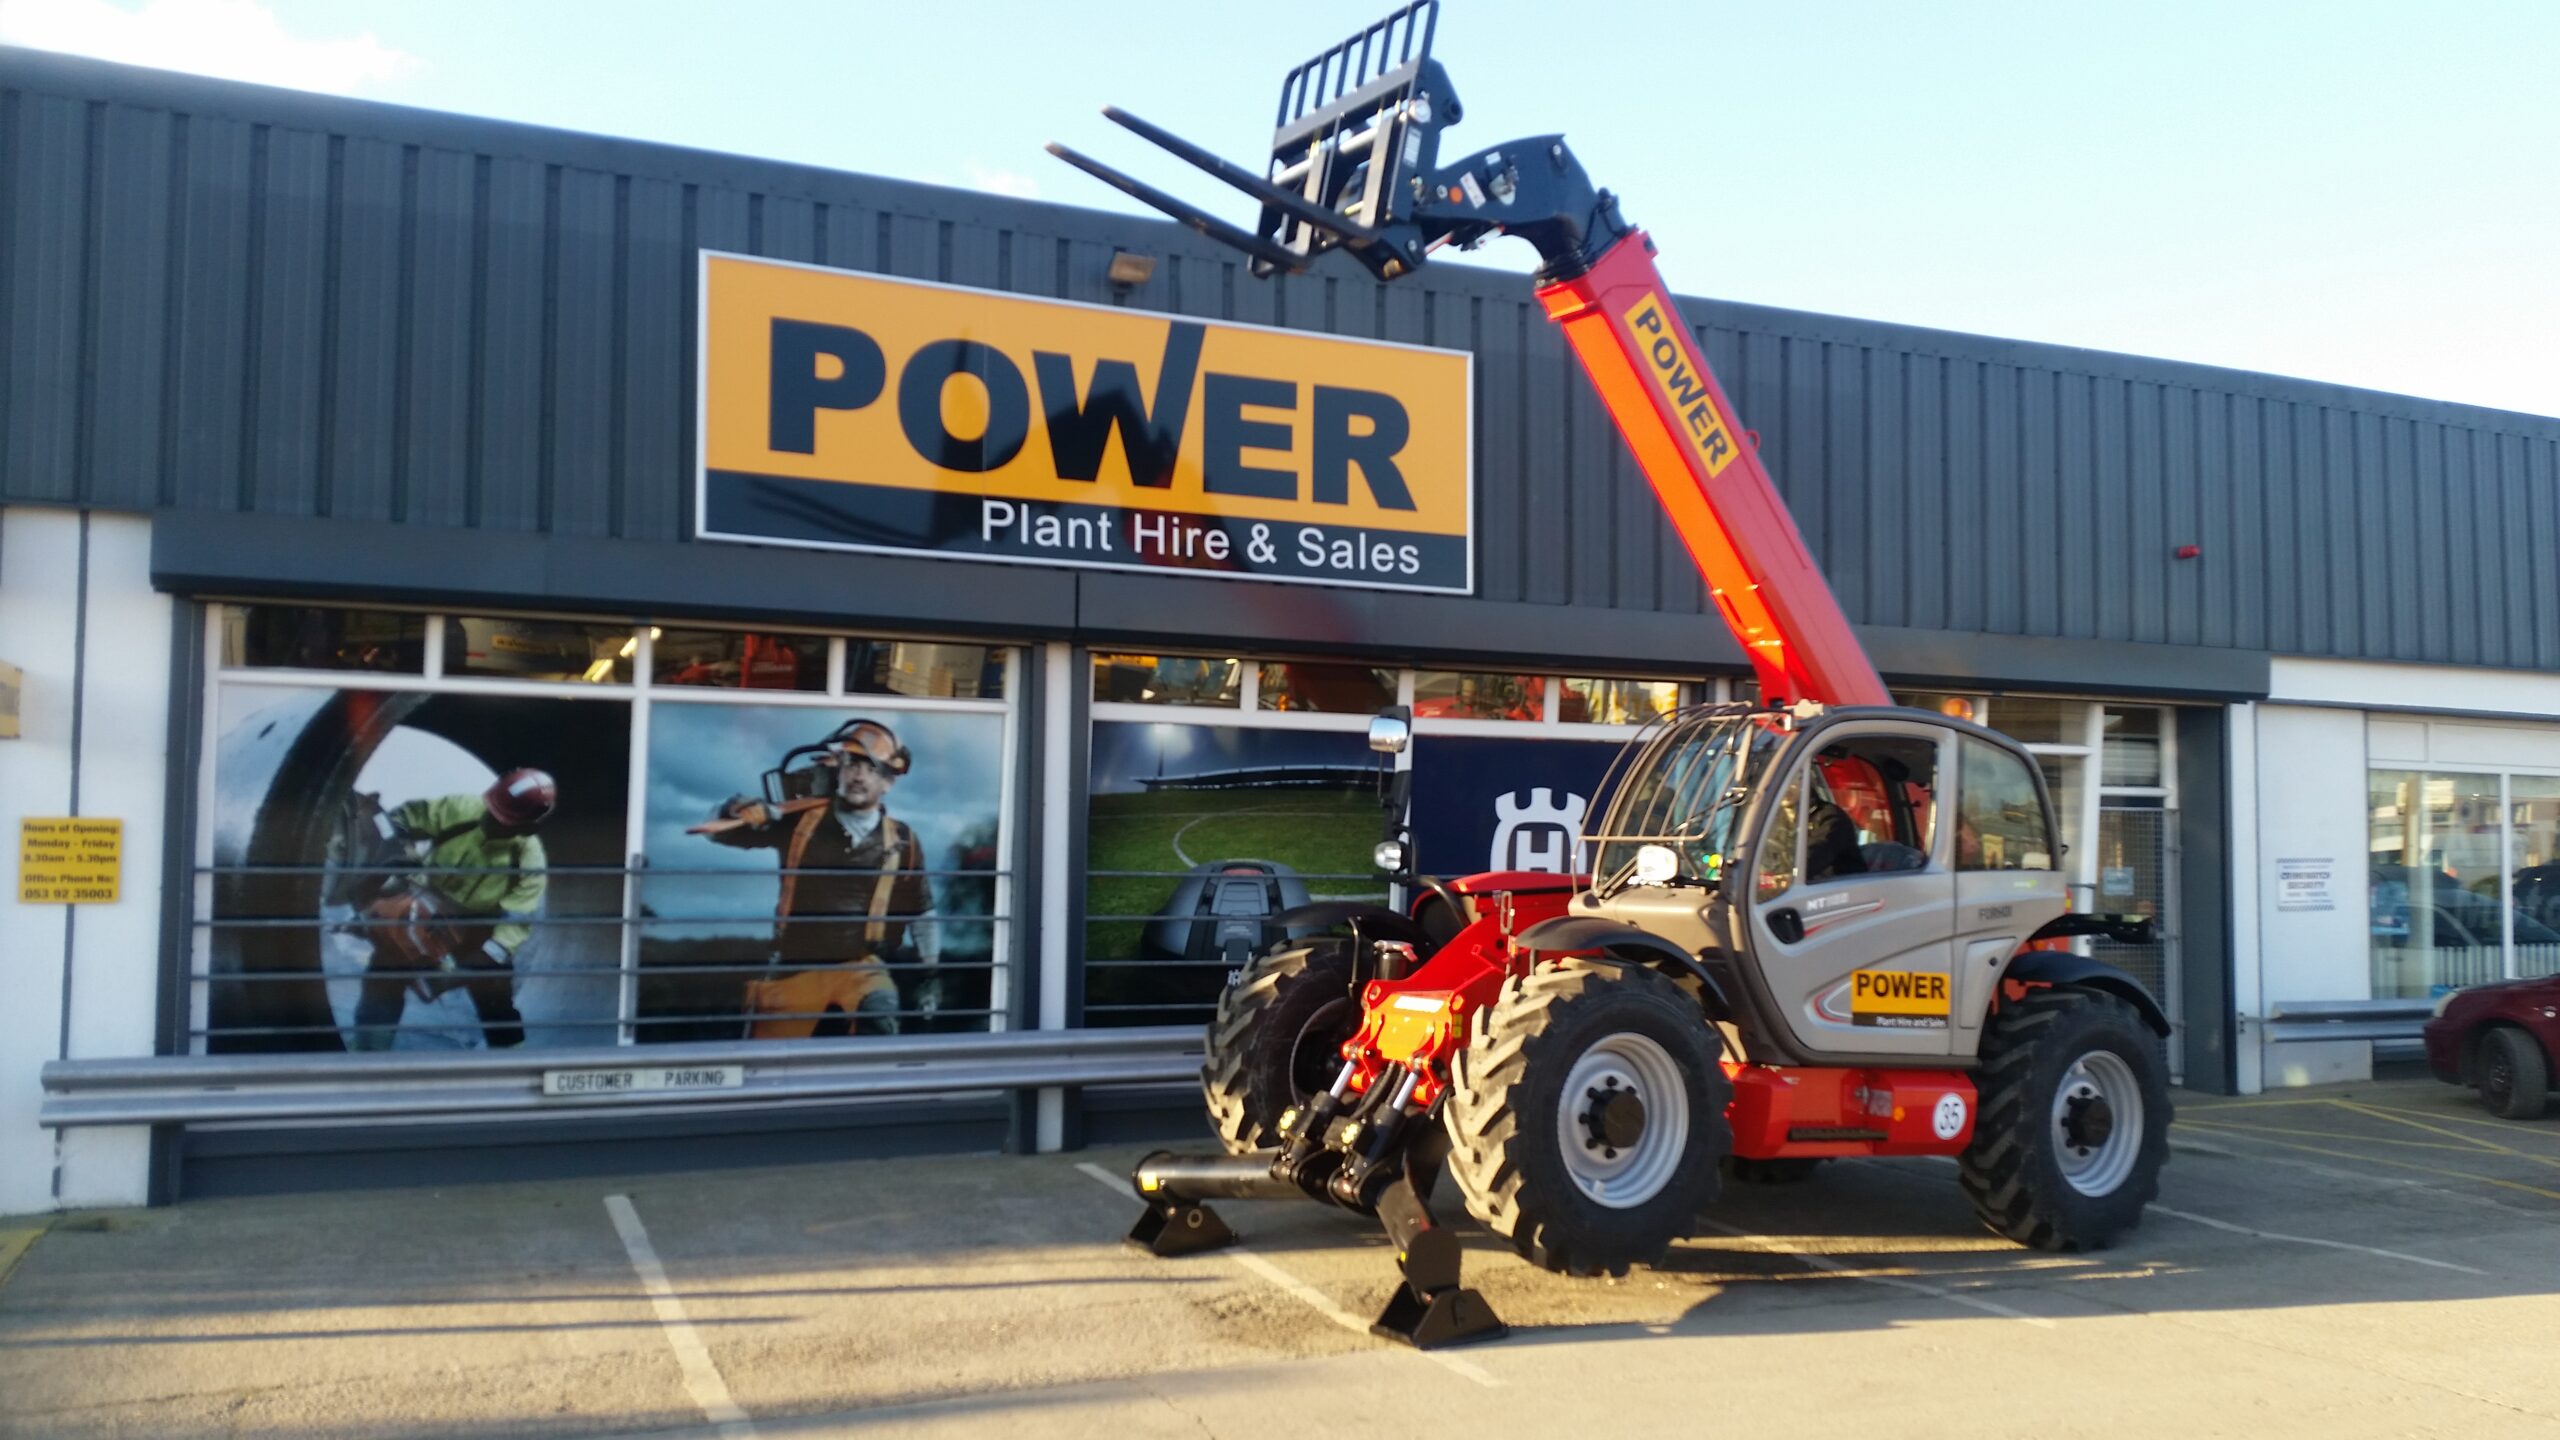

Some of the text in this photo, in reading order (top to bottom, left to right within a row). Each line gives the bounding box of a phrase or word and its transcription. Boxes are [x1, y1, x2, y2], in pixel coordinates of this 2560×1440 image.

[1635, 306, 1729, 466] POWER
[768, 316, 1419, 512] POWER
[982, 499, 1421, 575] Plant Hire & Sales
[23, 823, 55, 833] Hours
[59, 824, 70, 833] of
[27, 838, 71, 849] Monday
[82, 838, 115, 850] Friday
[25, 874, 56, 883] Office
[60, 874, 93, 883] Phone
[25, 889, 48, 899] 053
[1856, 972, 1945, 999] POWER
[1876, 1016, 1896, 1026] Plant
[556, 1069, 725, 1092] CUSTOMER PARKING
[1940, 1102, 1960, 1131] 35
